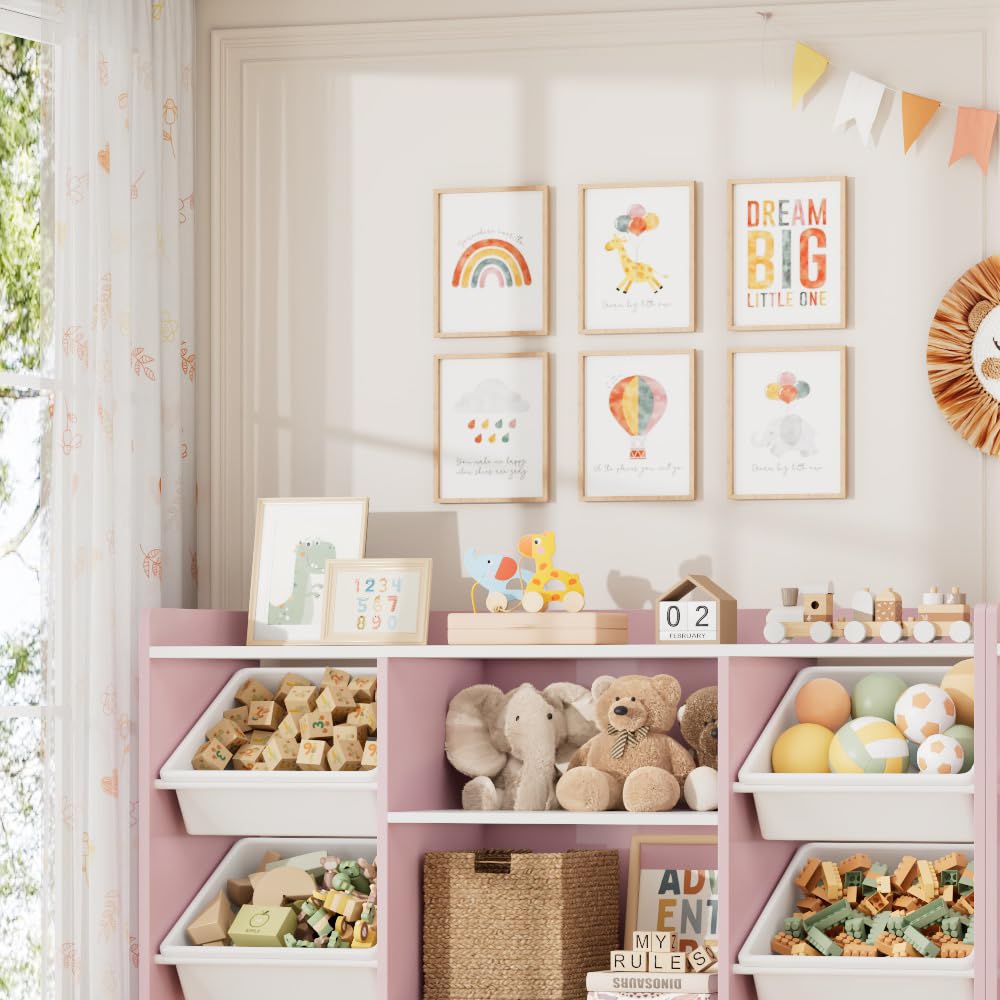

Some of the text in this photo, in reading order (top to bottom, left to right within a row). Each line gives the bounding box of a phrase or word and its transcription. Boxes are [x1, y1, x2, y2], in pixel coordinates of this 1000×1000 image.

[747, 198, 827, 227] DREAM
[747, 228, 827, 289] BIG
[747, 291, 827, 308] LITTLE ONE
[365, 579, 375, 592] 2
[636, 934, 666, 949] MY
[614, 951, 706, 970] RULES
[612, 977, 682, 990] DINOSAURS
